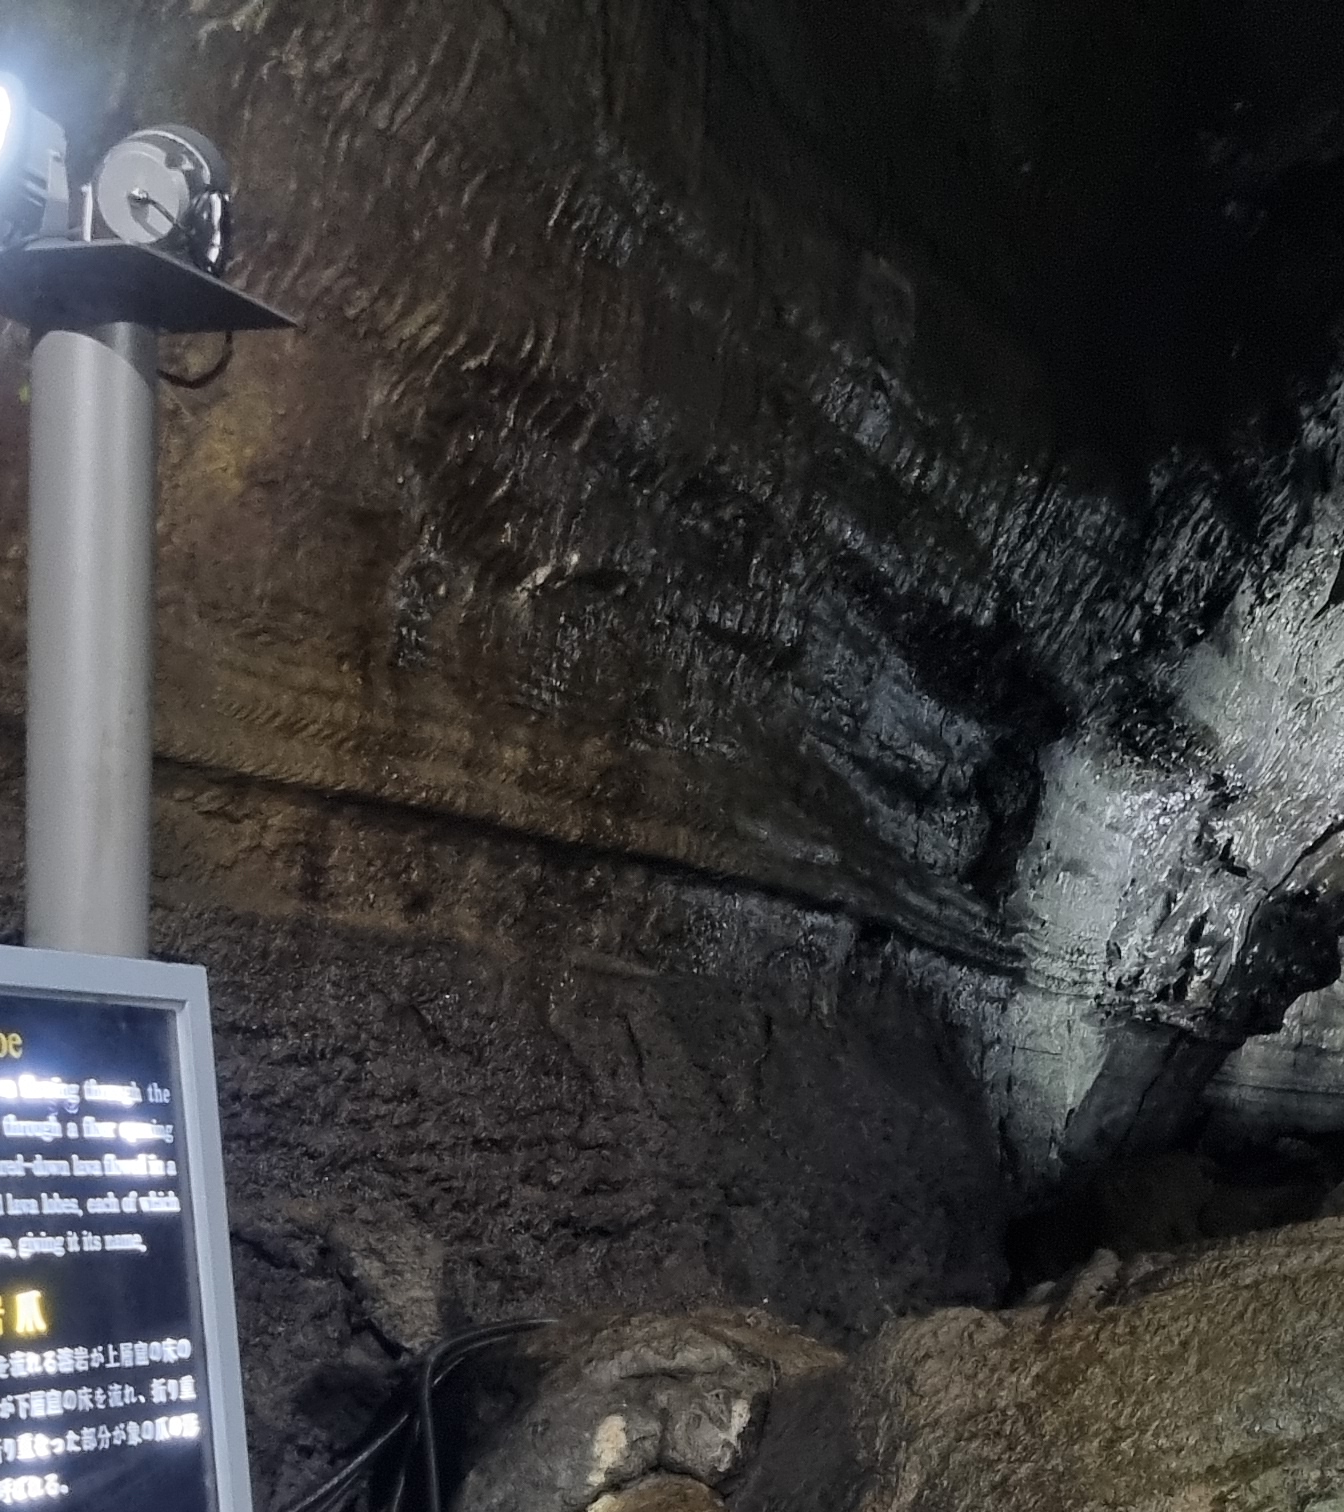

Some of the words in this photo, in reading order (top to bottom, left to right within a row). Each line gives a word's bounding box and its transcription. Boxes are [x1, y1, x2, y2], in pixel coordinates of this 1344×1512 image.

[18, 1073, 80, 1106] fling
[147, 1082, 171, 1104] the
[3, 1113, 63, 1142] through
[66, 1121, 79, 1139] a
[118, 1117, 174, 1144] ping
[72, 1153, 103, 1177] lava
[167, 1160, 178, 1177] a
[66, 1230, 81, 1252] it
[82, 1230, 102, 1252] its
